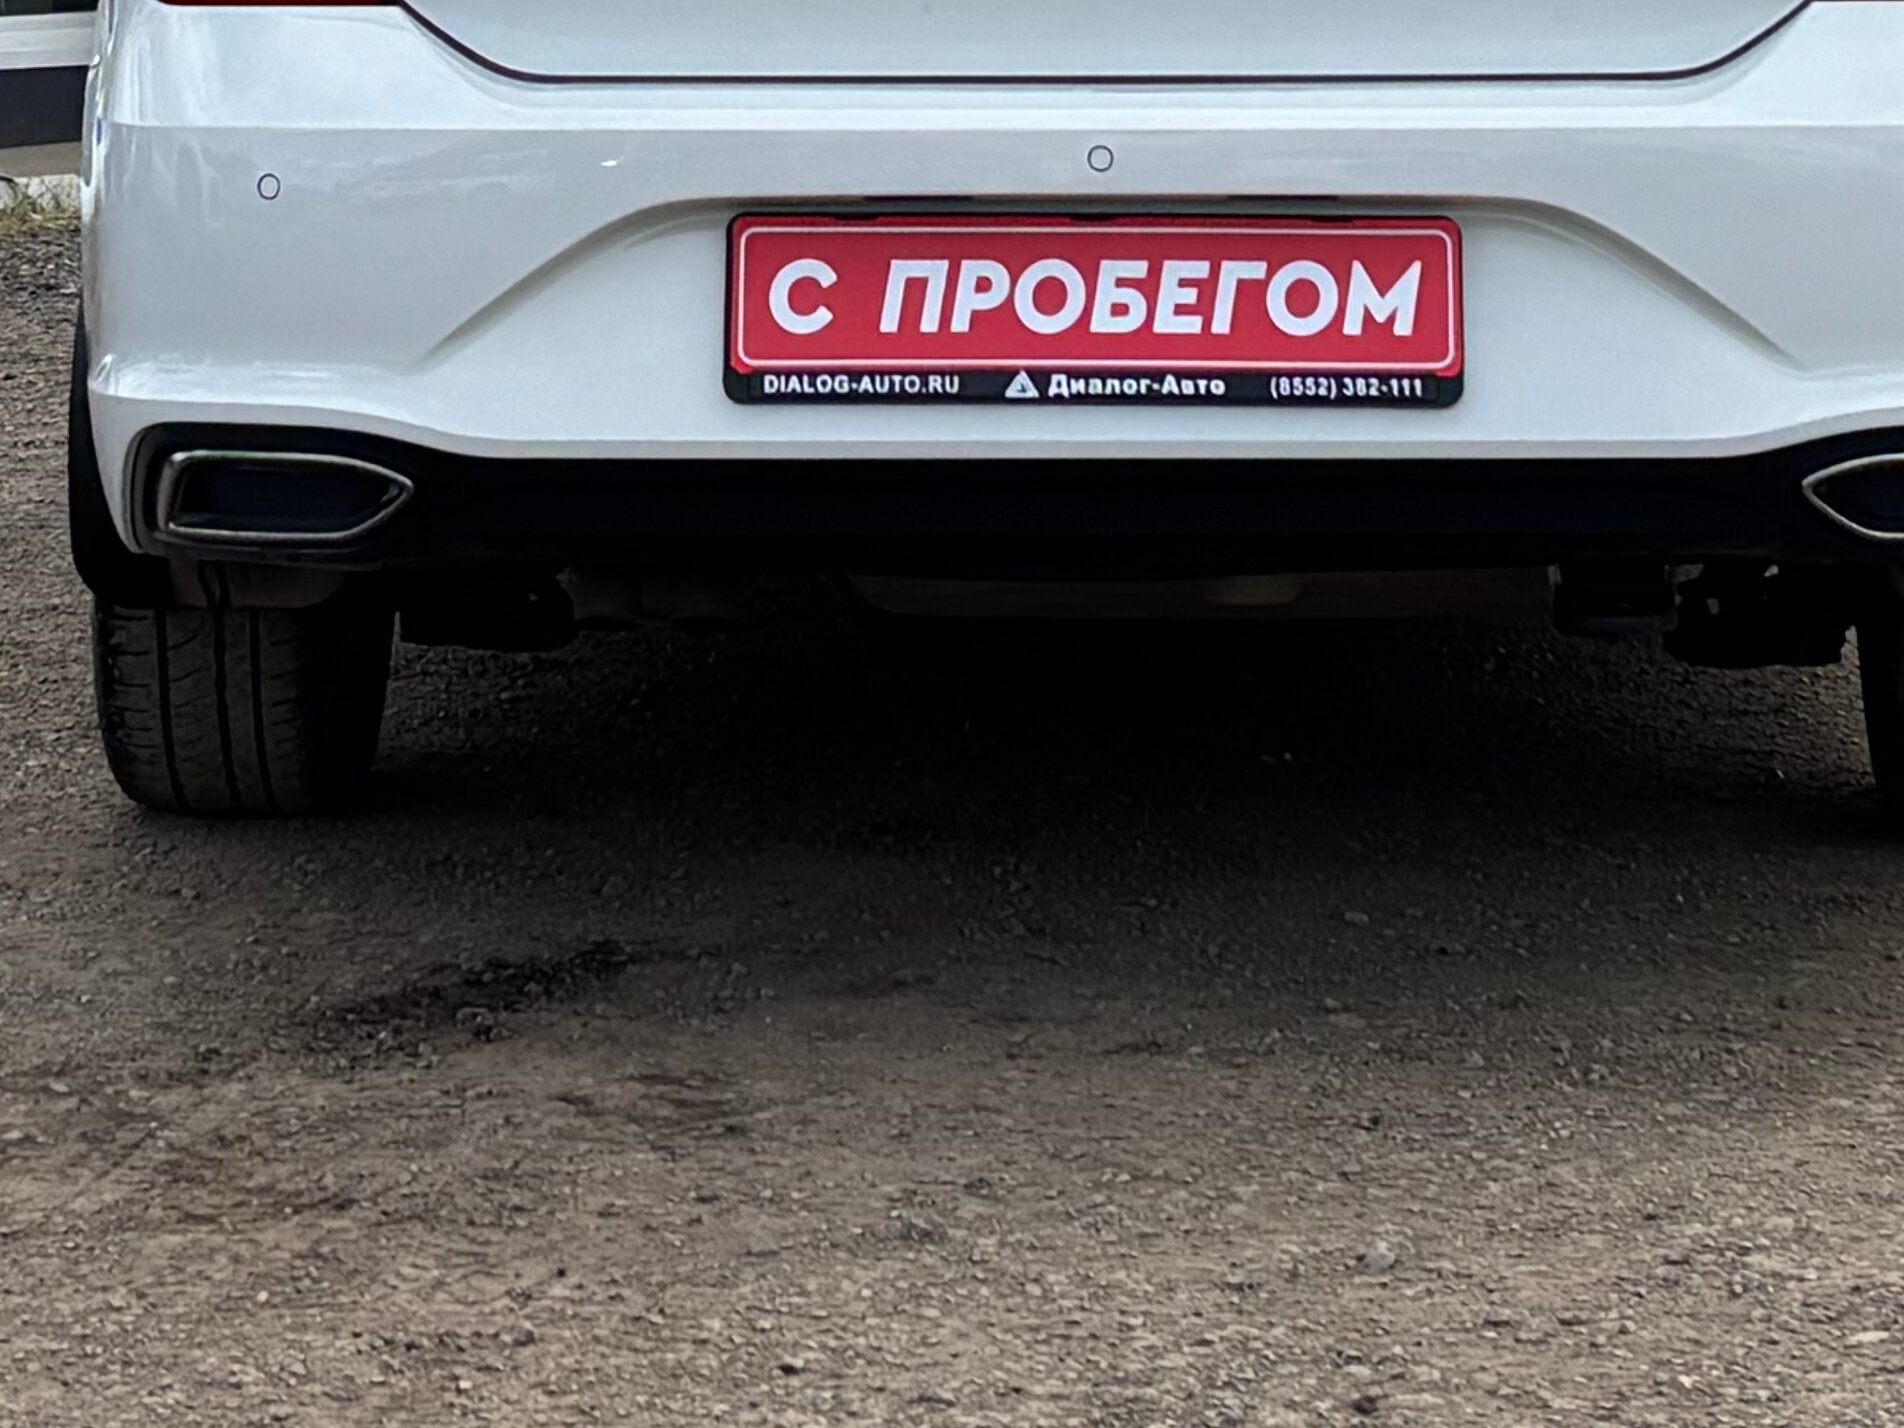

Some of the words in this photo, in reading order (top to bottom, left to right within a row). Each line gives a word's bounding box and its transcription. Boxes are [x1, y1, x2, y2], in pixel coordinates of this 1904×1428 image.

[769, 259, 837, 333] С
[880, 259, 1422, 336] ПРОБЕГОМ
[763, 374, 960, 394] DIALOG-AUTO.RU
[1048, 373, 1226, 398] Диалог-Авто
[1270, 376, 1337, 400] (8552)
[1343, 377, 1423, 396] 382-111
